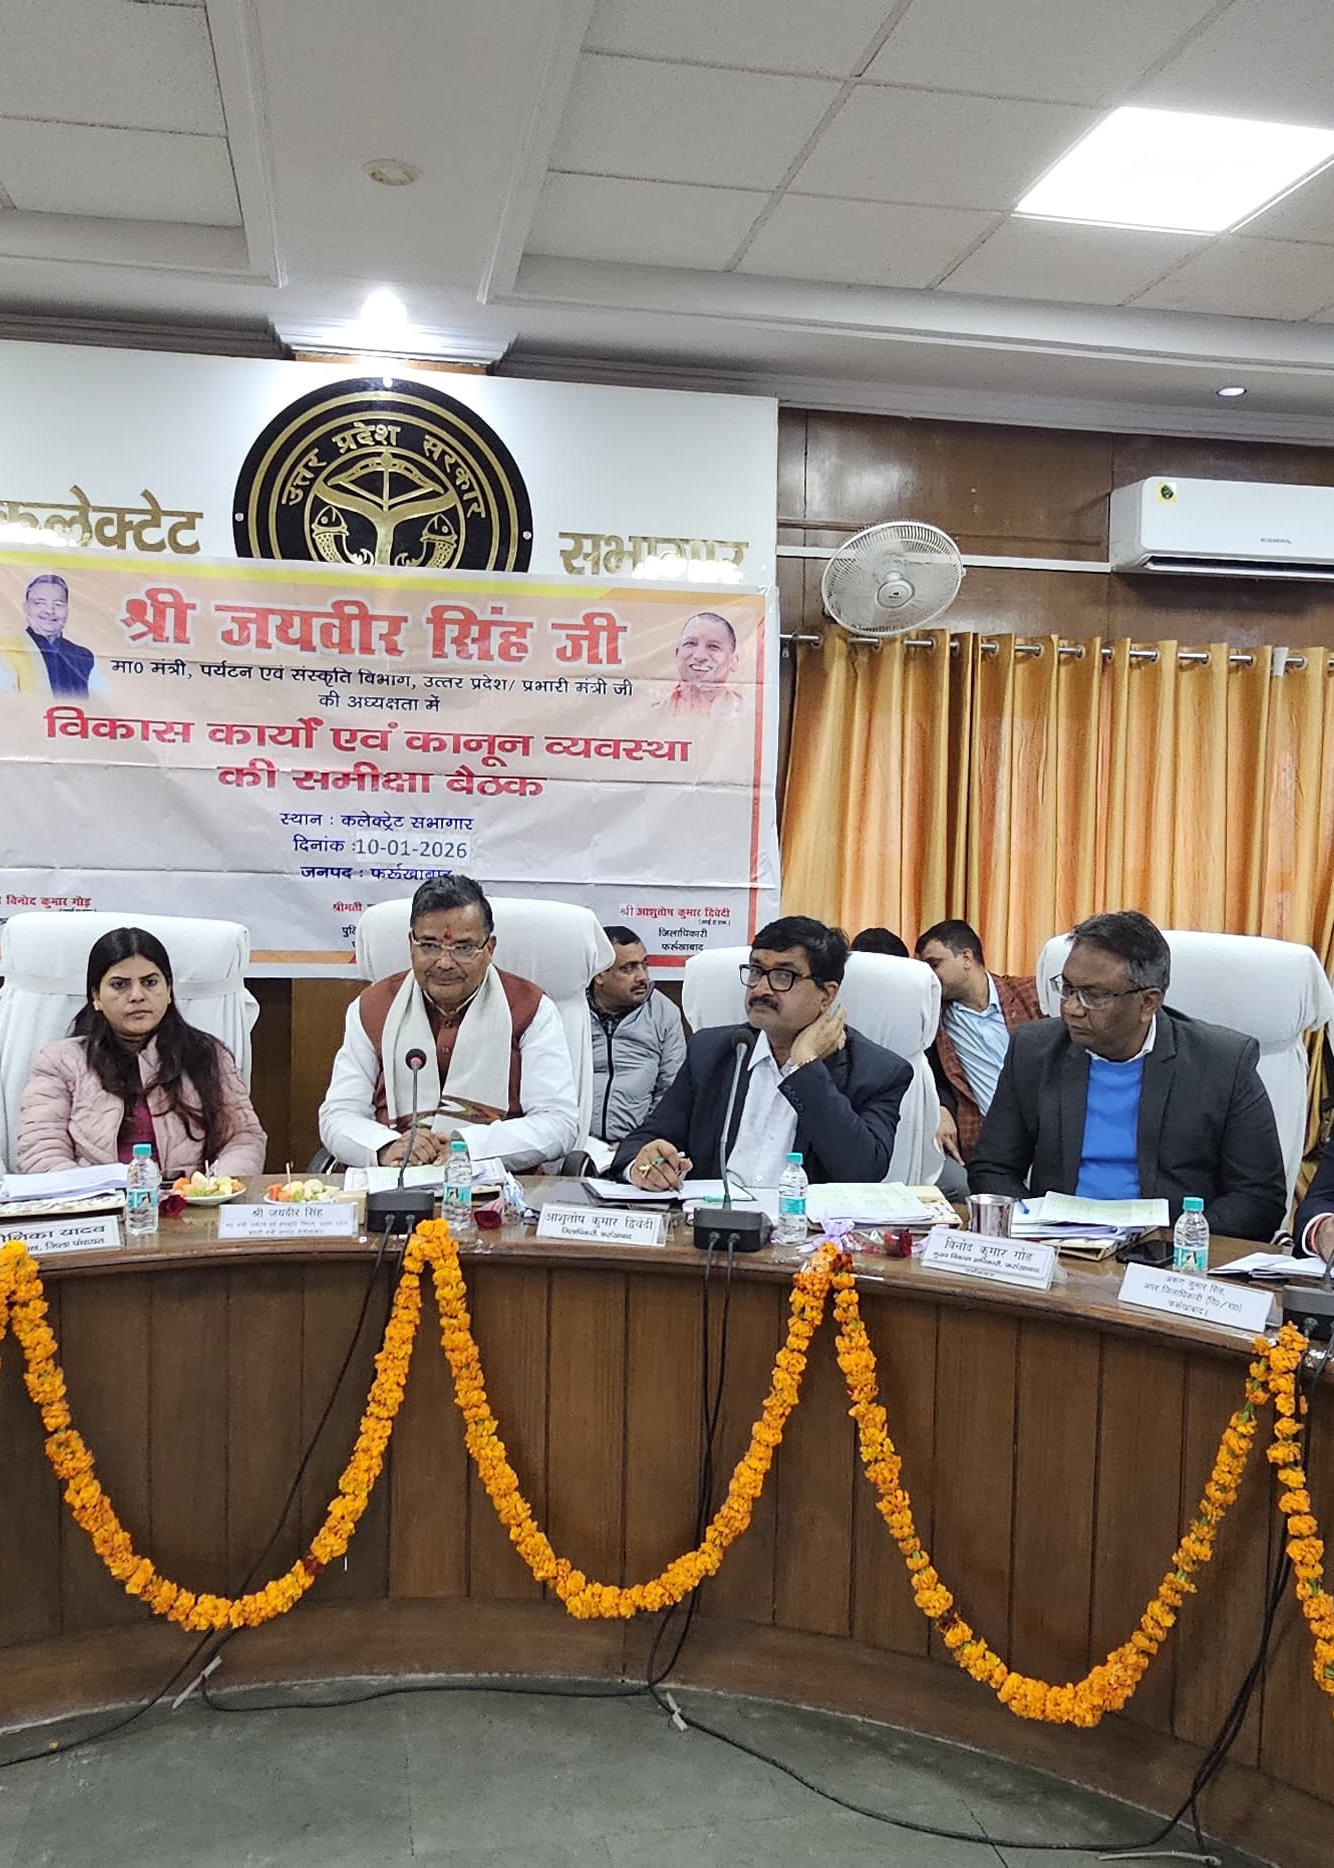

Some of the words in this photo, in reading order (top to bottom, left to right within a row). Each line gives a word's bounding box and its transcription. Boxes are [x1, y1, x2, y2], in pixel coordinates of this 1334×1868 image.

[282, 448, 327, 506] उत्तर
[332, 422, 401, 453] प्रदेश
[424, 435, 486, 518] सरकार
[121, 587, 197, 645] श्री
[215, 599, 408, 656] जयवीर
[426, 604, 533, 662] सिंह
[551, 612, 627, 665] जी
[150, 658, 192, 680] मंत्री,
[200, 660, 251, 679] पर्यटन
[259, 664, 284, 681] एवं
[290, 664, 352, 687] संस्कृति
[359, 669, 416, 690] विभाग,
[522, 677, 568, 694] प्रभारी
[575, 677, 606, 695] मंत्री
[613, 679, 633, 696] जी
[318, 690, 340, 709] की
[347, 695, 419, 712] अध्यक्षता
[425, 694, 440, 713] में
[43, 706, 195, 744] विकास
[329, 721, 398, 752] एवं
[404, 729, 534, 768] कानून
[544, 735, 692, 762] व्यवस्था
[217, 758, 279, 789] की
[292, 761, 434, 793] समीक्षा
[444, 764, 547, 797] बैठक
[279, 812, 323, 826] स्थान
[340, 810, 404, 832] कलेक्ट्रेट
[410, 816, 474, 831] सभागार
[293, 833, 345, 852] दिनांक
[300, 866, 353, 879] जनपद
[41, 896, 68, 909] कुमार
[619, 904, 633, 917] श्री
[636, 906, 673, 919] आशुतोष
[678, 907, 701, 919] कुमार
[59, 1225, 105, 1237] यादव
[591, 1217, 618, 1228] कुमार
